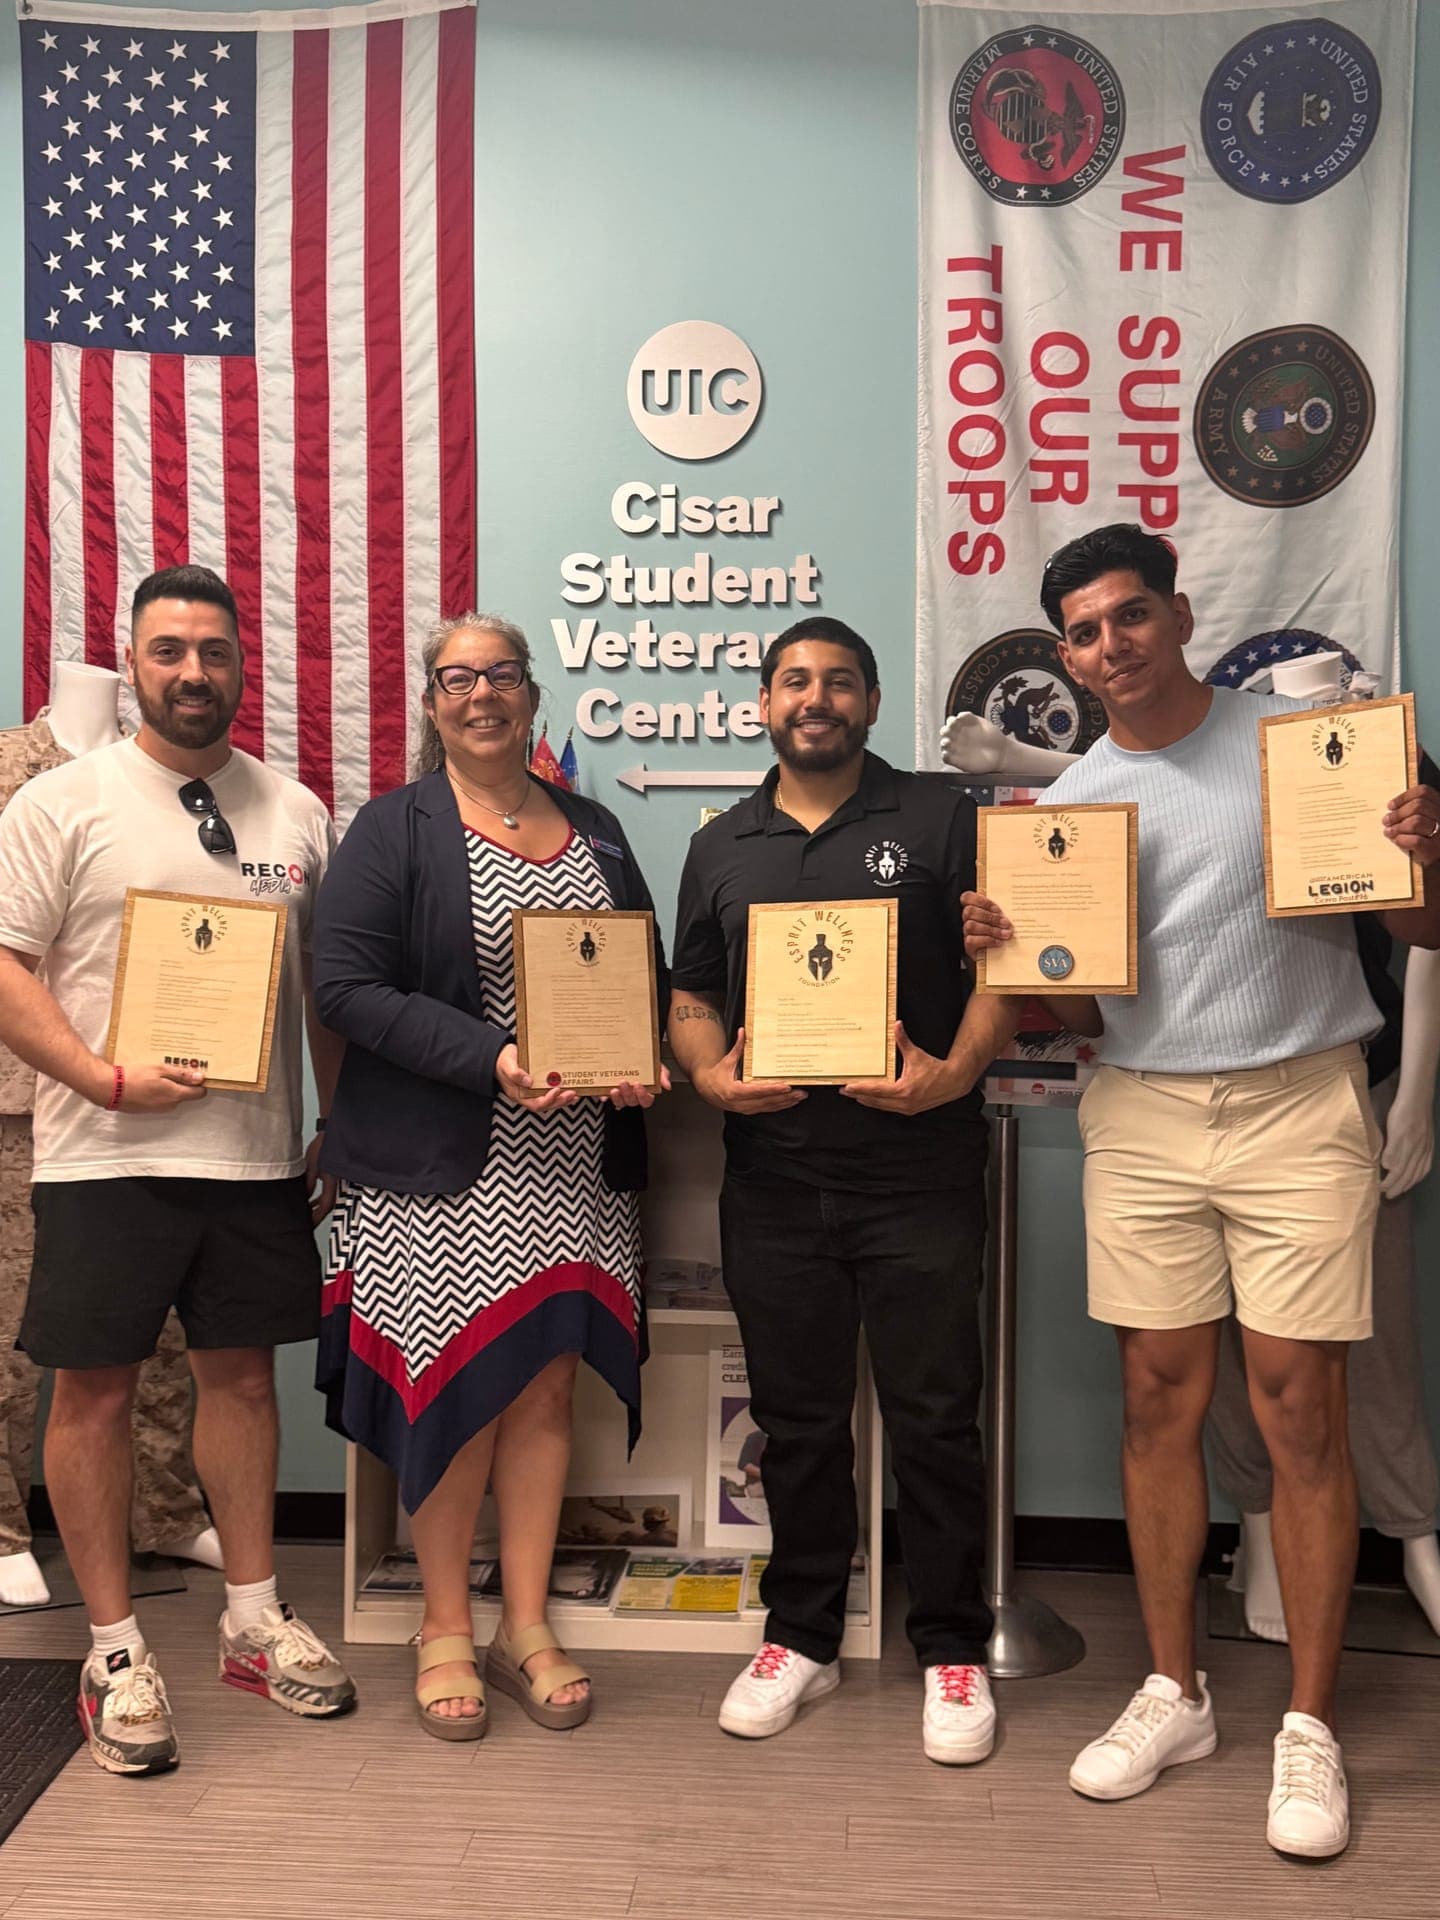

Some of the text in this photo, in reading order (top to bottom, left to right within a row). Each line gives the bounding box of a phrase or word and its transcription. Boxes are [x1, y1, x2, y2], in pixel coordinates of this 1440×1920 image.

[956, 43, 1003, 190] MARINE CORPS
[1072, 47, 1120, 188] UNITED STATES
[1216, 52, 1259, 177] AIR FORCE
[1313, 38, 1369, 179] UNITED STATES
[1117, 144, 1187, 564] WE SUPP
[640, 368, 750, 416] UIC
[947, 244, 1007, 576] TROOPS
[1029, 331, 1091, 505] OUR
[1208, 387, 1229, 457] ARMY
[1312, 345, 1361, 484] UNITED STATES
[610, 480, 781, 535] Cisar
[559, 551, 820, 605] Student
[241, 863, 310, 887] RECON
[1308, 880, 1374, 897] LEGION
[787, 910, 854, 964] ESPRIT WELLNESS
[1044, 958, 1067, 968] SVA
[164, 1056, 209, 1069] RECON
[599, 1070, 640, 1078] VETERANS
